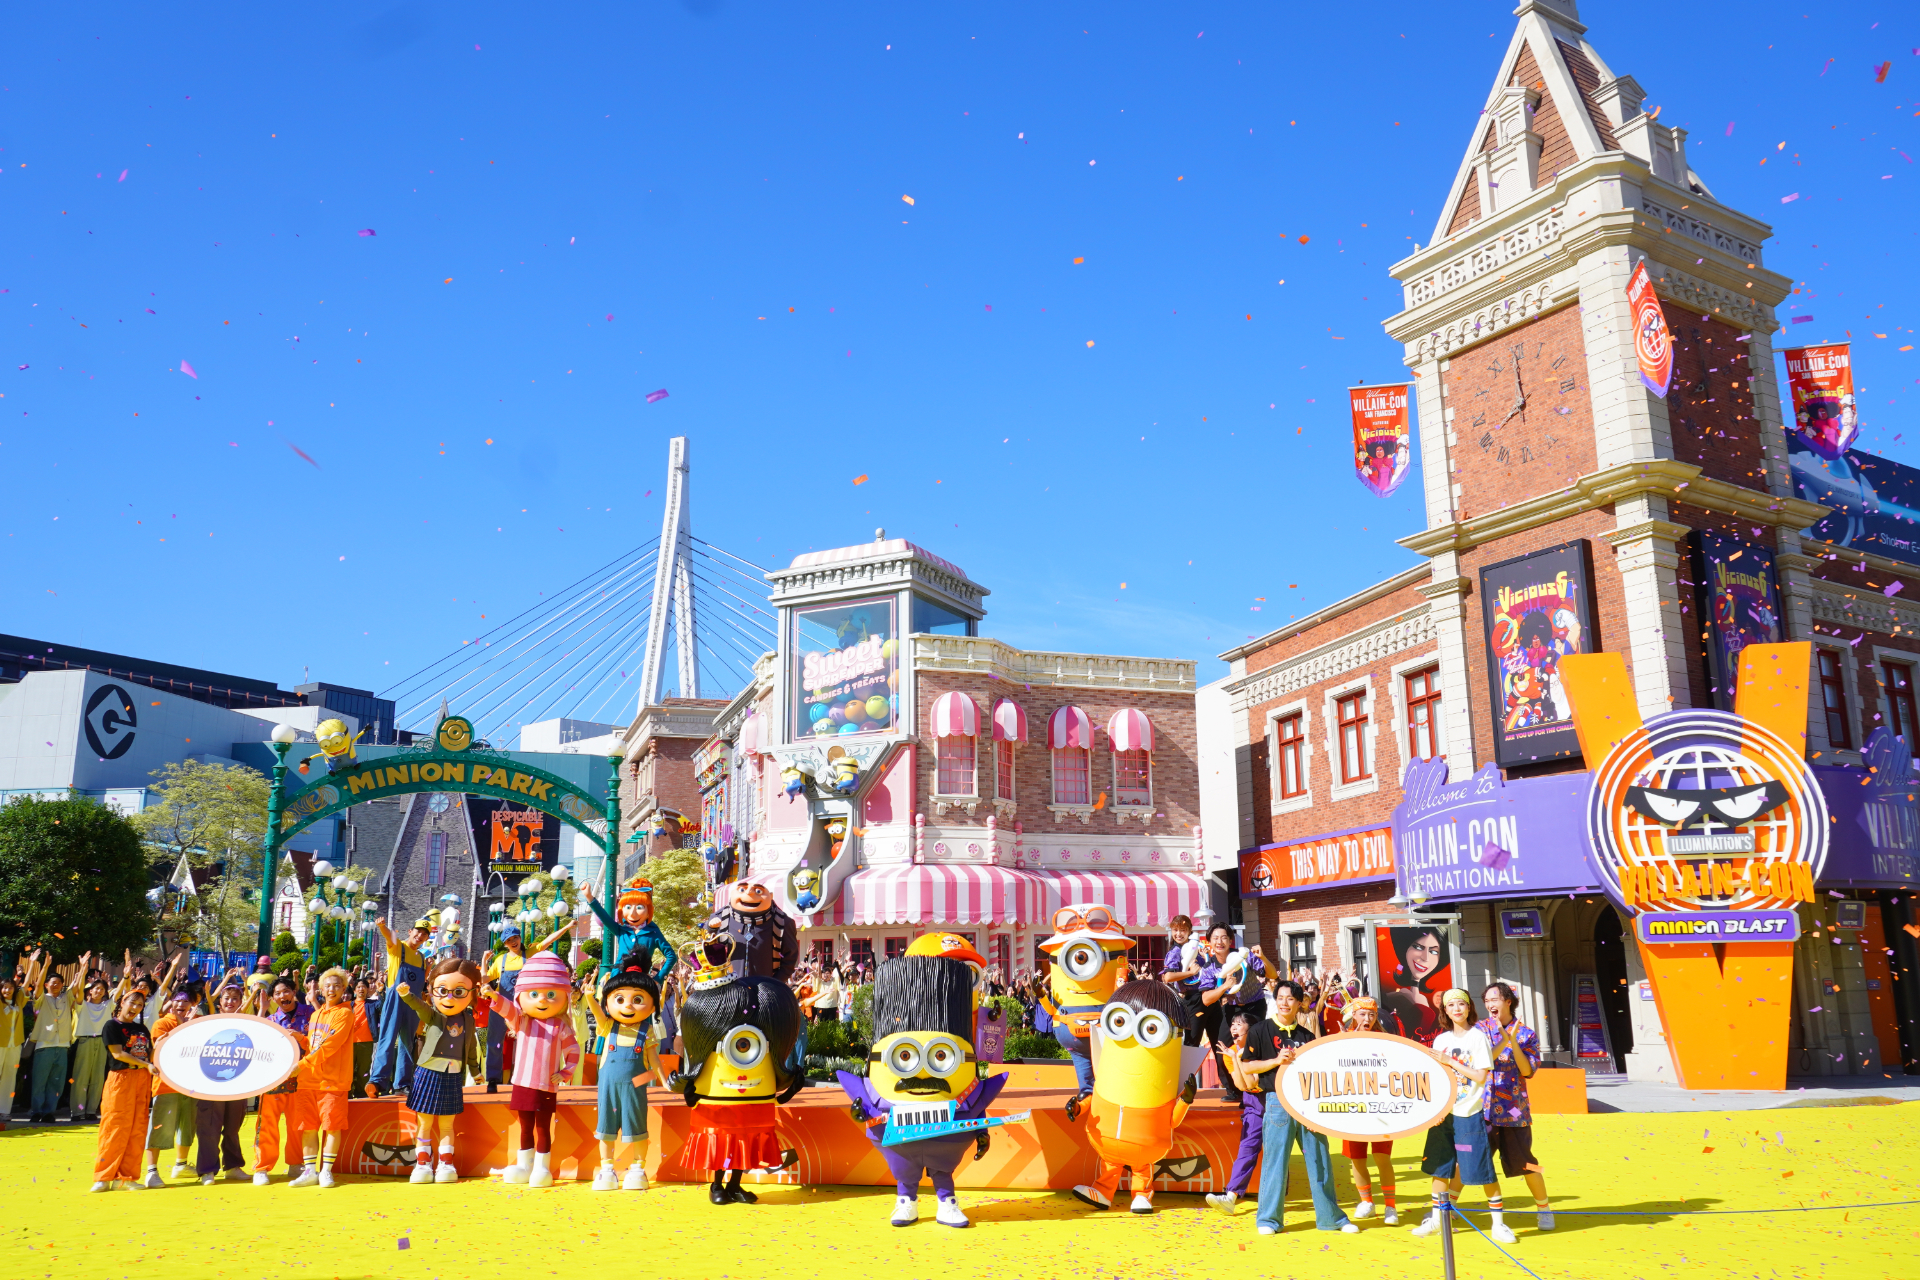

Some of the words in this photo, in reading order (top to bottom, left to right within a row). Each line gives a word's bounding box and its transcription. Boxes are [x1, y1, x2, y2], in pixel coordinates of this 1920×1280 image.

[1788, 355, 1849, 373] VILLAIN-CON
[1353, 395, 1407, 412] VILLAIN-CON
[1364, 411, 1374, 419] SAN
[1374, 409, 1397, 418] FRANCISCO
[1881, 532, 1898, 548] Shot
[803, 634, 885, 679] Sweet
[803, 657, 886, 692] SURRENDER
[804, 688, 842, 704] CANDIES
[844, 683, 851, 695] &
[852, 675, 886, 690] TREATS
[347, 762, 465, 795] MINION
[471, 764, 554, 801] PARK
[1404, 764, 1468, 819] Welcome
[1474, 769, 1496, 795] to
[492, 810, 544, 822] DESPICABLE
[490, 821, 544, 860] ME
[1401, 815, 1519, 872] VILLAIN-CON
[1671, 836, 1753, 852] ILLUMINATION'S
[1290, 847, 1314, 880] THIS
[1316, 843, 1340, 877] WAY
[1343, 839, 1360, 873] TO
[1363, 834, 1391, 870] EVIL
[492, 864, 514, 872] MINION
[515, 864, 540, 872] MAYHEM
[1617, 861, 1816, 907] VILLAIN-CON
[1723, 918, 1789, 934] BLAST
[209, 1058, 239, 1067] JAPAN
[233, 1047, 275, 1063] STUDIOS
[1338, 1058, 1388, 1068] ILLUMINATION'S
[1298, 1071, 1431, 1102] VILLAIN-CON
[1368, 1102, 1413, 1114] BLAST
